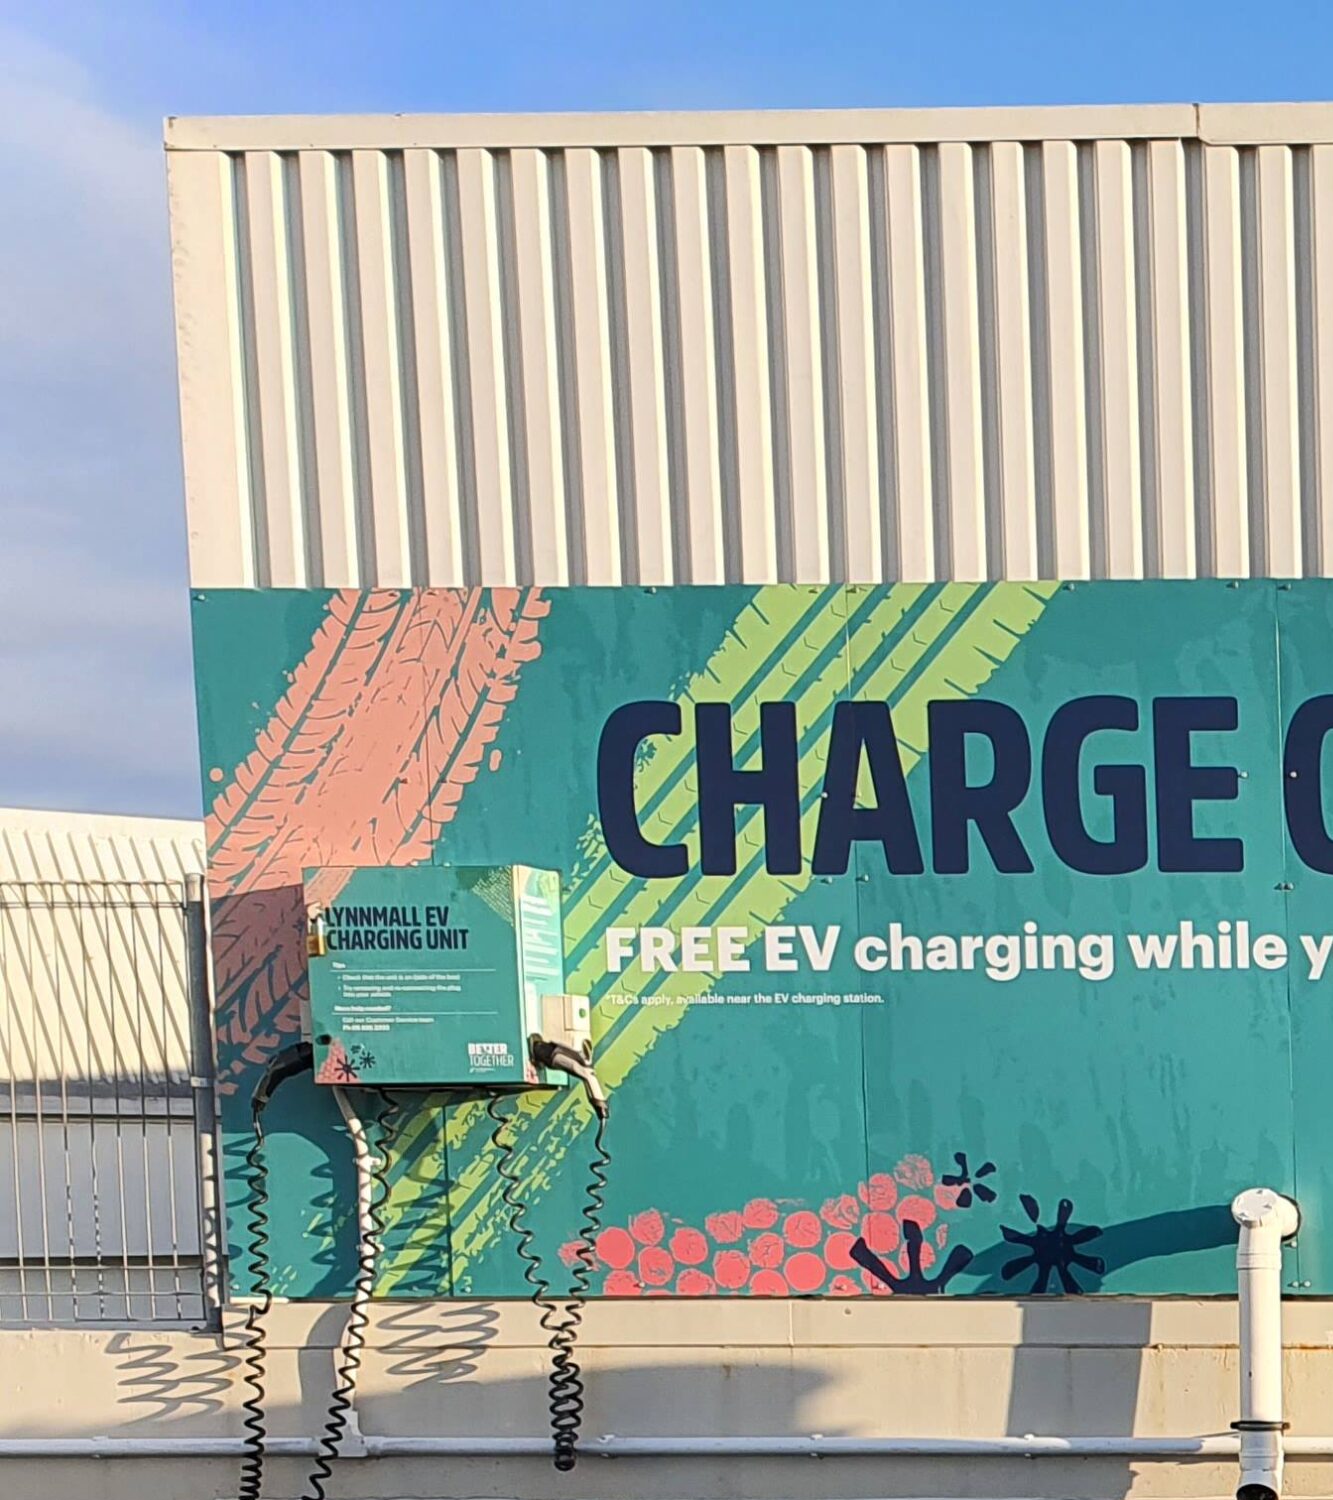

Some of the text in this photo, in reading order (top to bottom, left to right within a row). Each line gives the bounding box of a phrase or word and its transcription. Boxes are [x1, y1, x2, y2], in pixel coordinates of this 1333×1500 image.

[598, 694, 1245, 880] CHARGE
[325, 905, 449, 927] LYNNMALL EV
[326, 928, 469, 950] CHARGING UNIT
[605, 925, 751, 973] FREE
[764, 924, 841, 972] EV
[854, 922, 1115, 981] charging
[1127, 920, 1288, 971] while
[676, 993, 725, 1005] available
[726, 995, 751, 1005] near
[753, 993, 773, 1004] the
[774, 993, 790, 1004] EV
[791, 992, 841, 1006] charging
[843, 993, 885, 1004] station.
[468, 1042, 508, 1055] BETTER
[469, 1055, 514, 1067] TOGETHER
